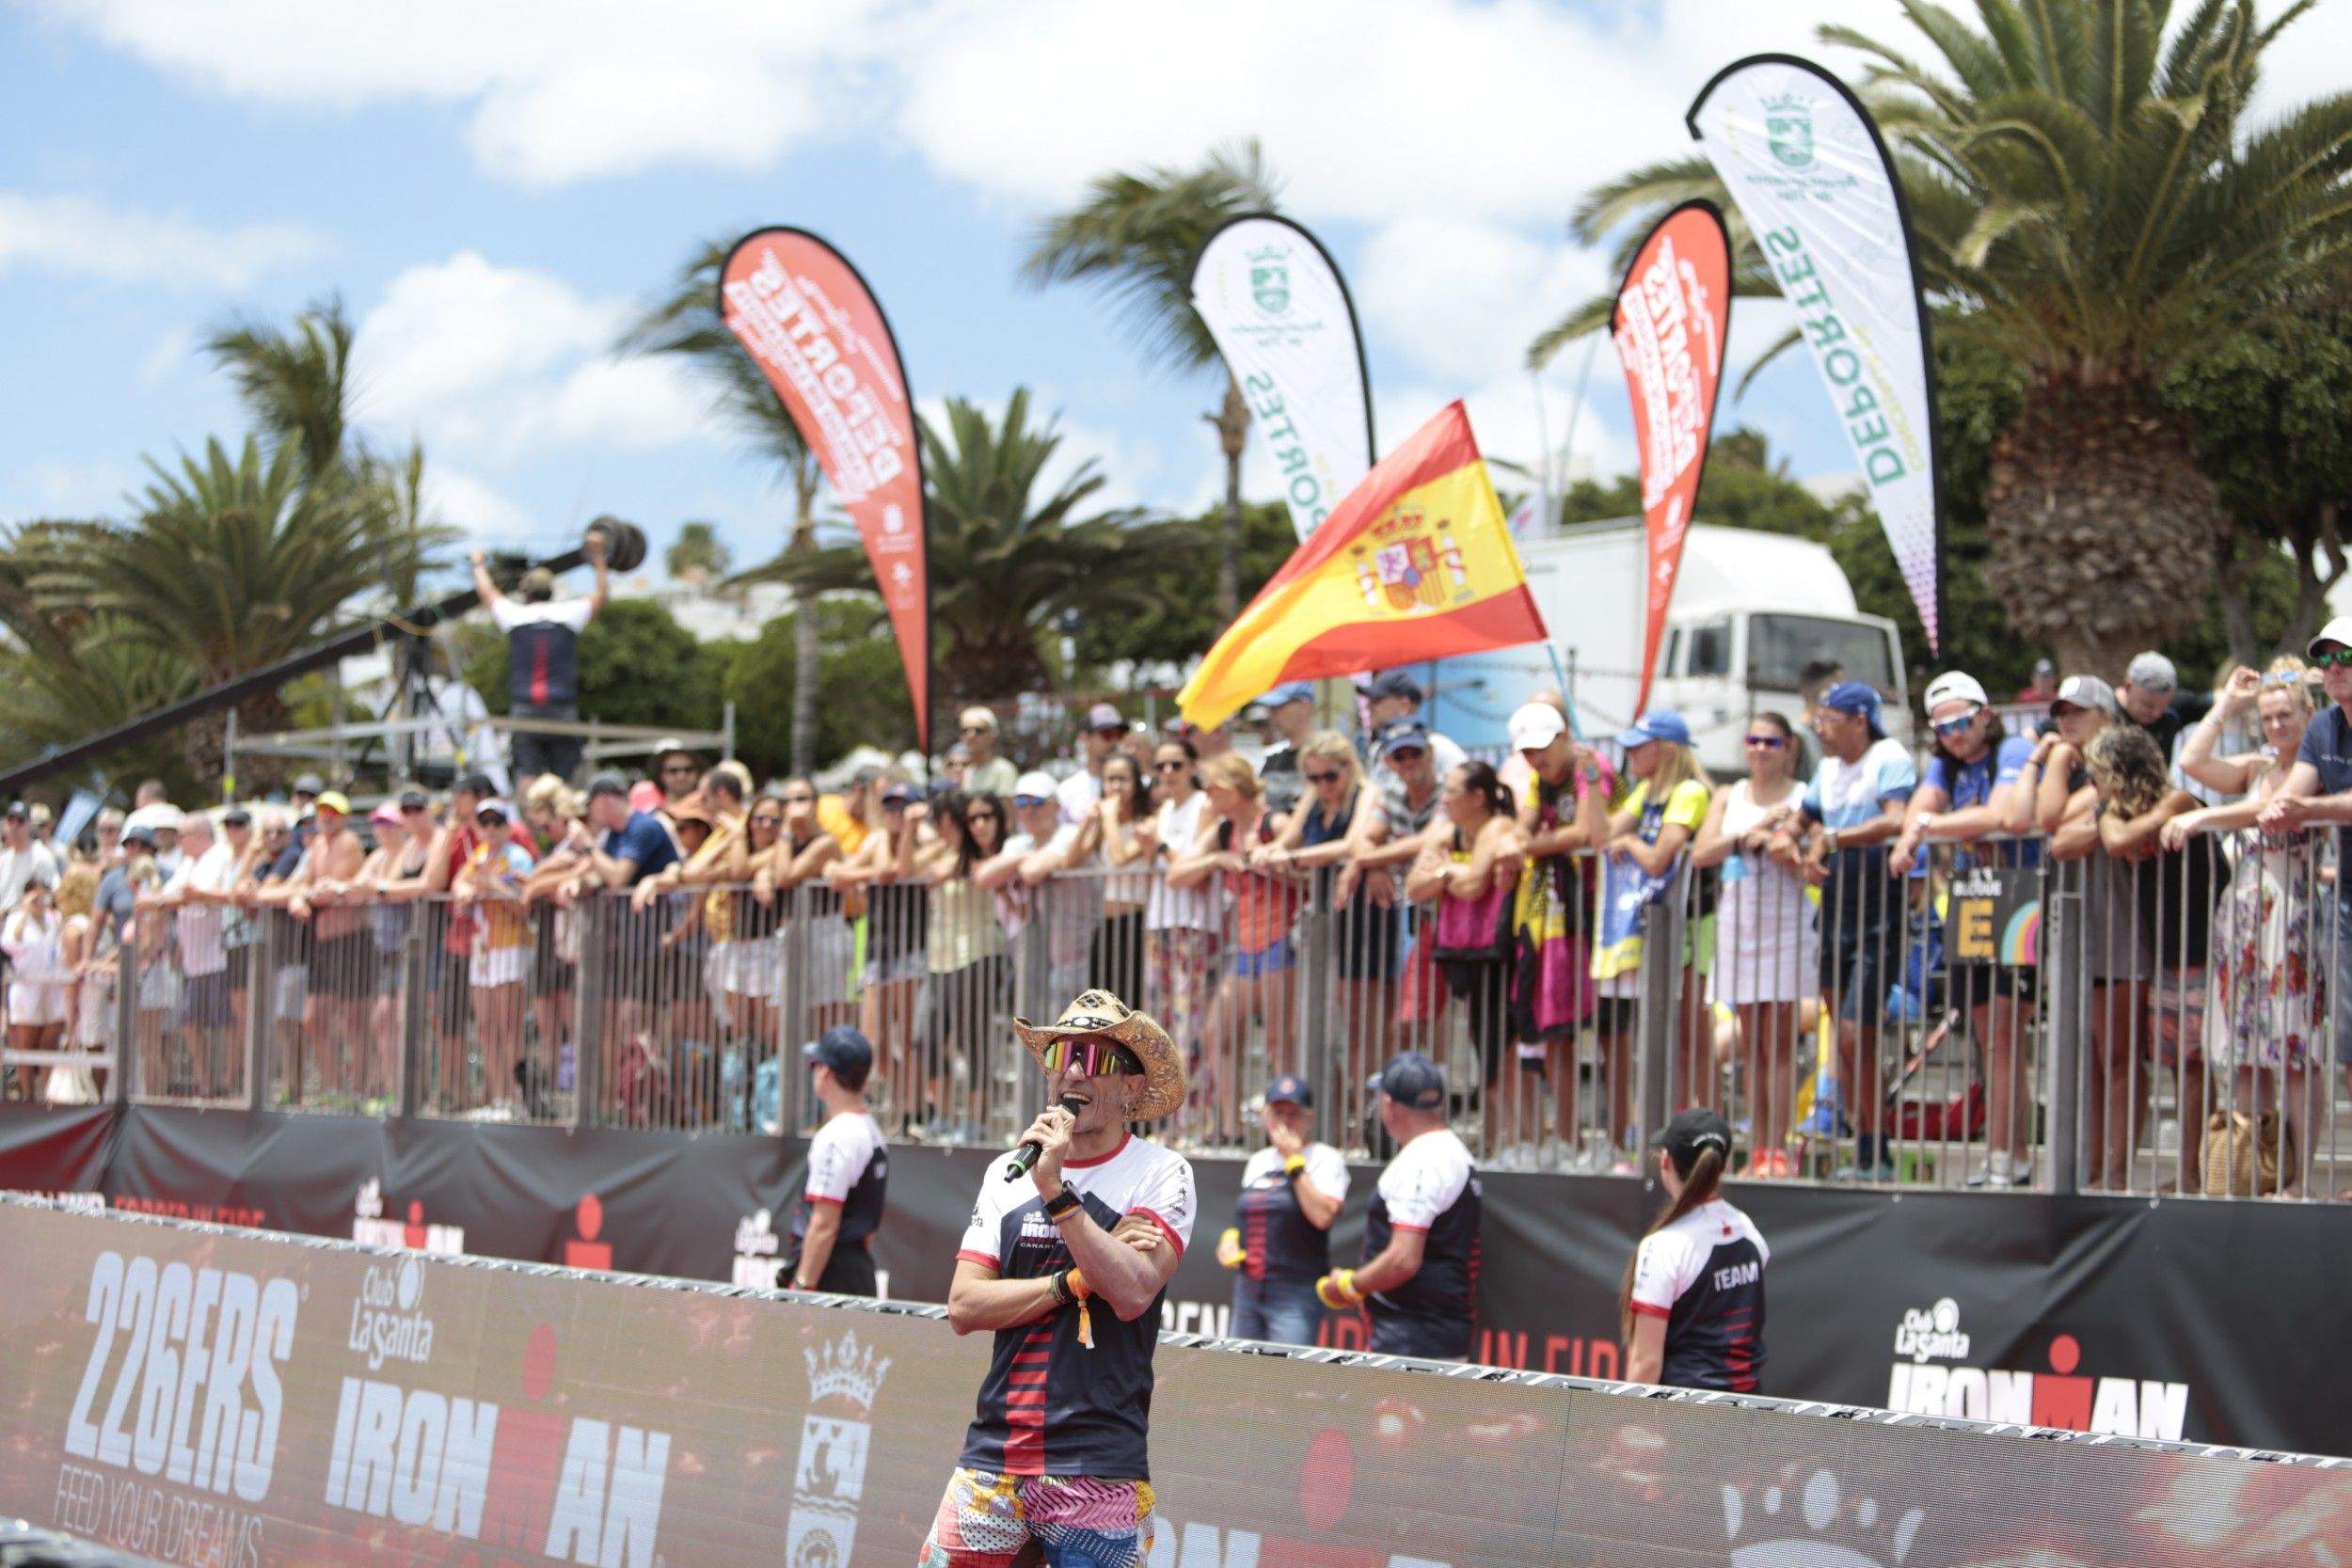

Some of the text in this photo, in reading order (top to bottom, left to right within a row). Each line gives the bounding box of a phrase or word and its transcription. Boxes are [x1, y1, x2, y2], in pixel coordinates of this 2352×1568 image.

[1958, 898, 1994, 958] E
[1021, 1223, 1061, 1239] IRON
[362, 1264, 395, 1307] Club
[1713, 1260, 1759, 1291] TEAM
[1904, 1307, 1933, 1332] Club
[65, 1250, 298, 1503] 226ERS
[1887, 1362, 2189, 1441] IRONMAN
[325, 1374, 672, 1568] IRONMAN
[54, 1464, 104, 1536] FEED
[107, 1478, 164, 1559] YOUR
[164, 1495, 263, 1568] DREAMS
